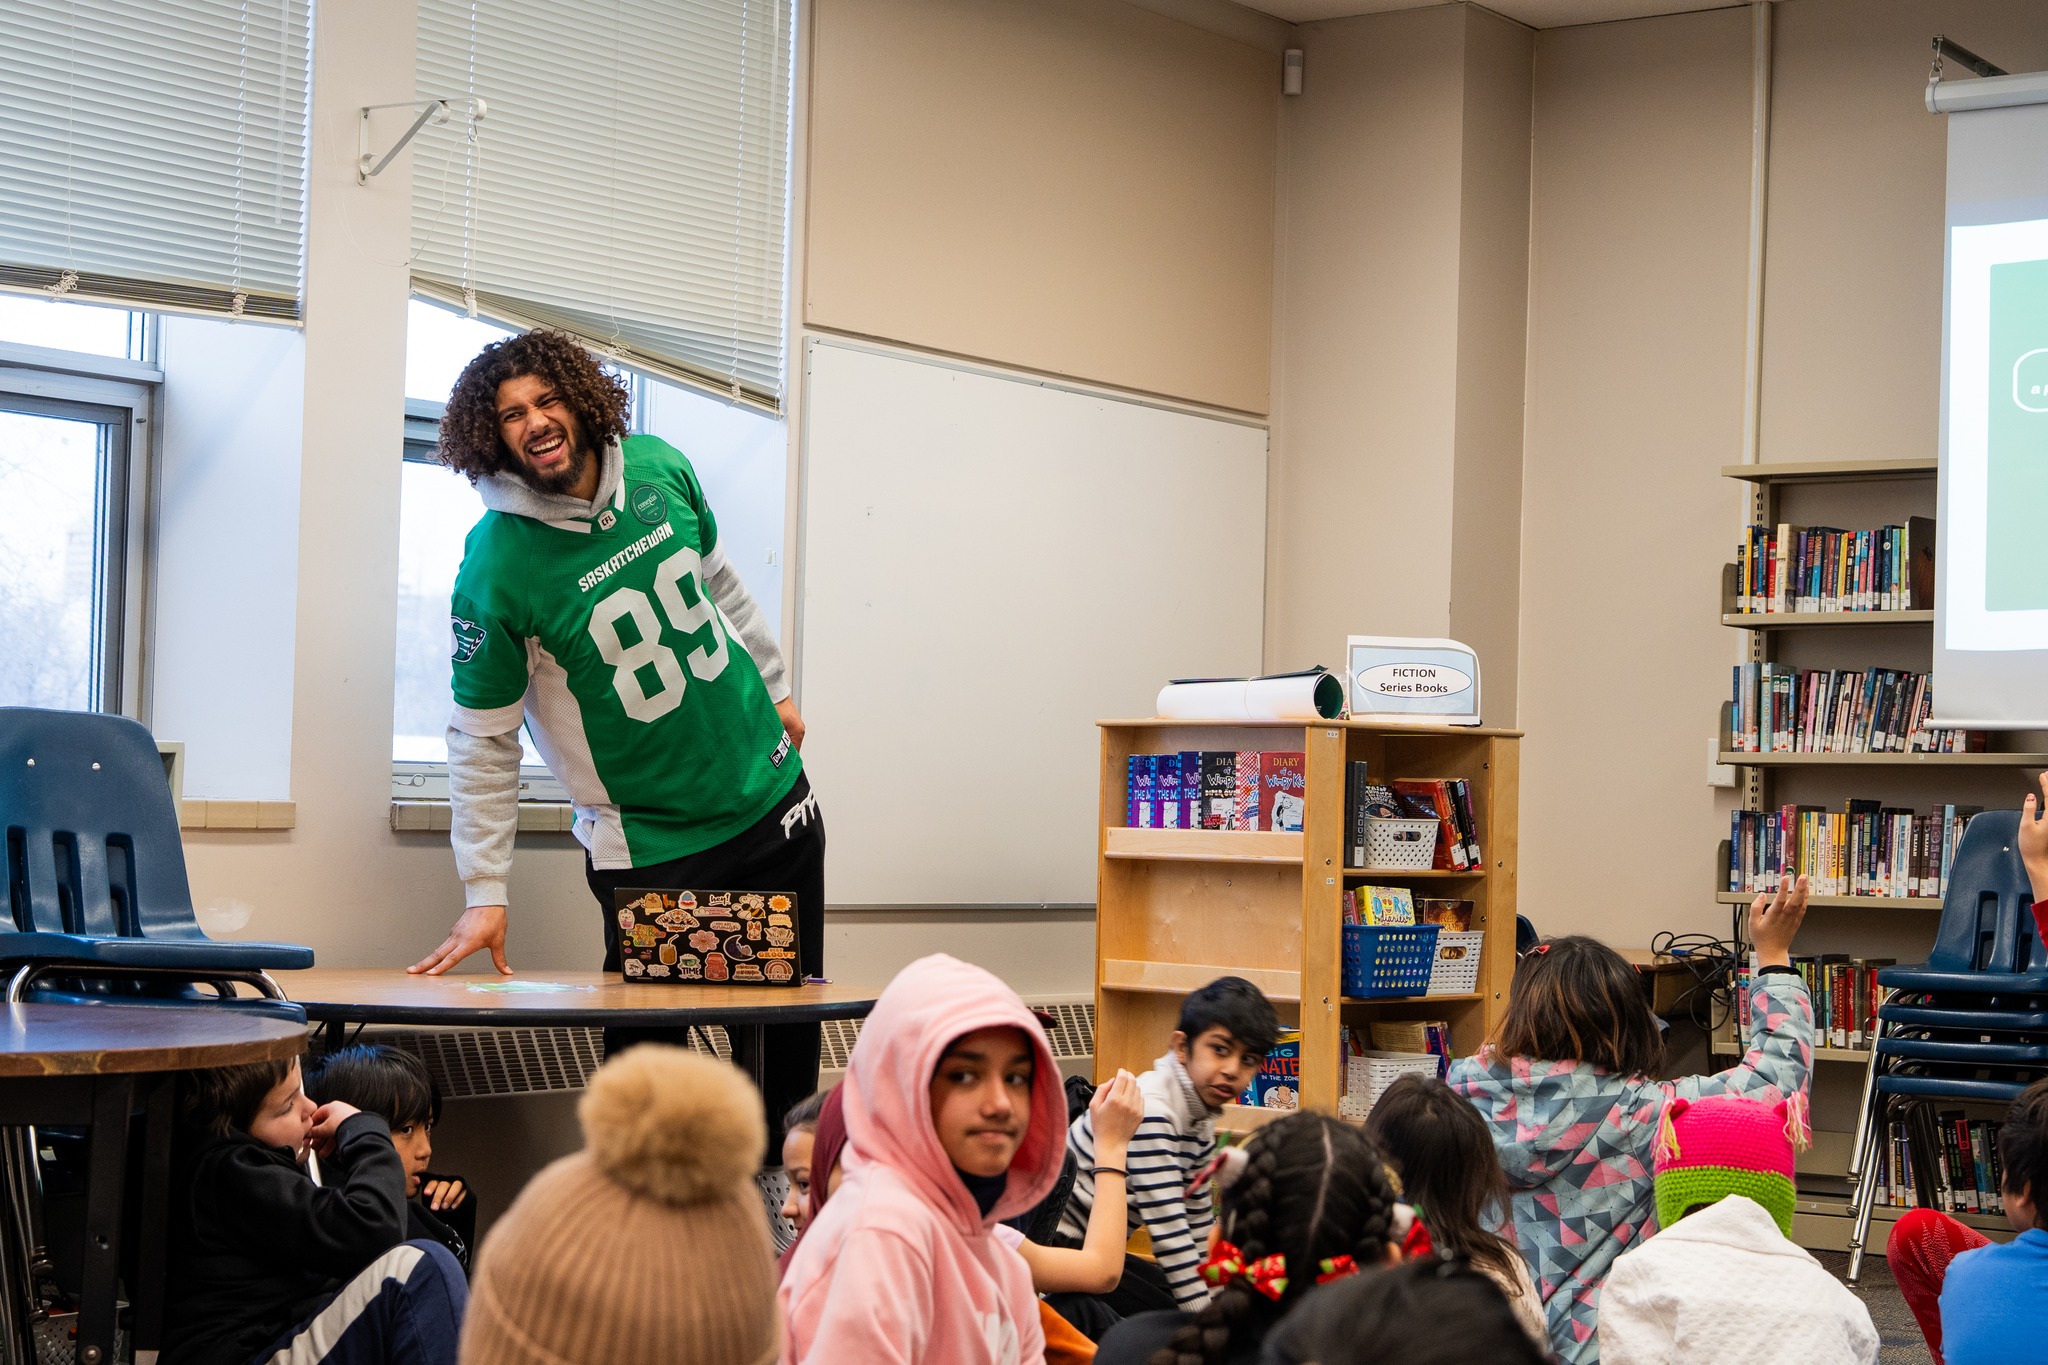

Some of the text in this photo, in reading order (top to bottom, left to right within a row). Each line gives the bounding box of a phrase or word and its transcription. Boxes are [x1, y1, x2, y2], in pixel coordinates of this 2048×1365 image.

[601, 515, 614, 527] CFL
[1814, 536, 1822, 566] DOMINION
[578, 521, 674, 593] SASKATCHEWAN
[588, 546, 730, 723] 89
[1392, 668, 1436, 678] FICTION
[1380, 682, 1448, 693] Series Books
[1273, 757, 1299, 766] DIARY
[1280, 767, 1286, 775] of
[1207, 774, 1236, 788] Wimpy
[1265, 775, 1292, 790] Wimpy
[1134, 790, 1145, 800] THE
[1158, 790, 1169, 800] THE
[1184, 788, 1196, 799] THE
[710, 893, 730, 906] hey!
[682, 967, 700, 975] TIME
[1259, 1058, 1299, 1075] NATE
